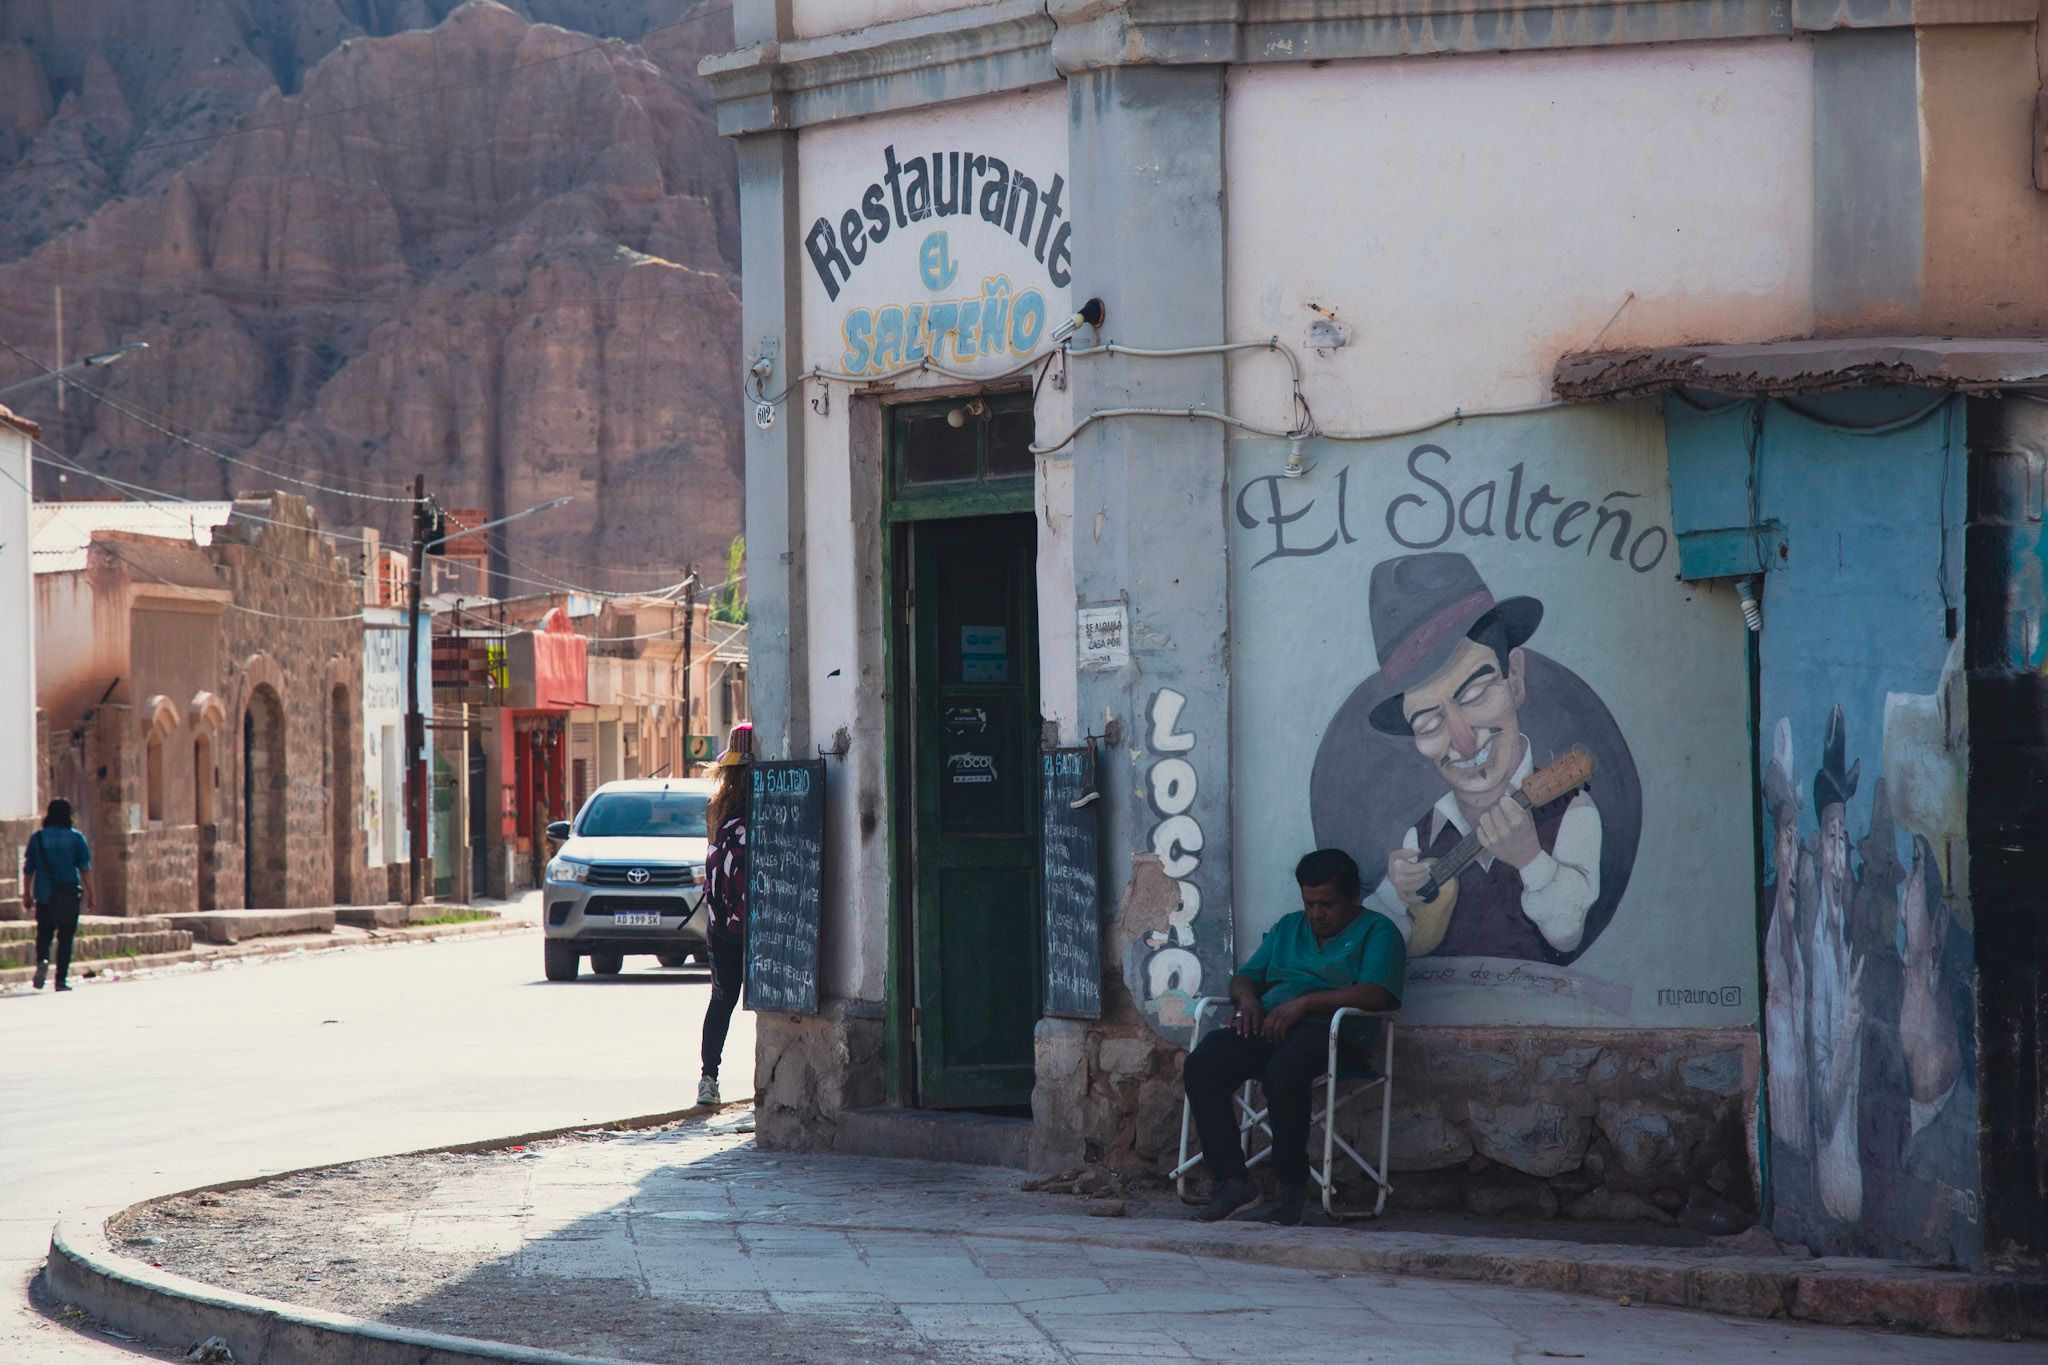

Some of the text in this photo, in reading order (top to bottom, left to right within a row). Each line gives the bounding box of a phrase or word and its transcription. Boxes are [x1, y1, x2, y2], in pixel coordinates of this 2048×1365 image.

[804, 144, 1071, 302] Restaurante
[919, 230, 958, 291] EL
[841, 274, 1047, 376] SALTEÑO
[757, 406, 771, 424] 602
[1236, 443, 1668, 573] El Salteño
[1088, 638, 1106, 650] CASA
[630, 915, 645, 925] 199
